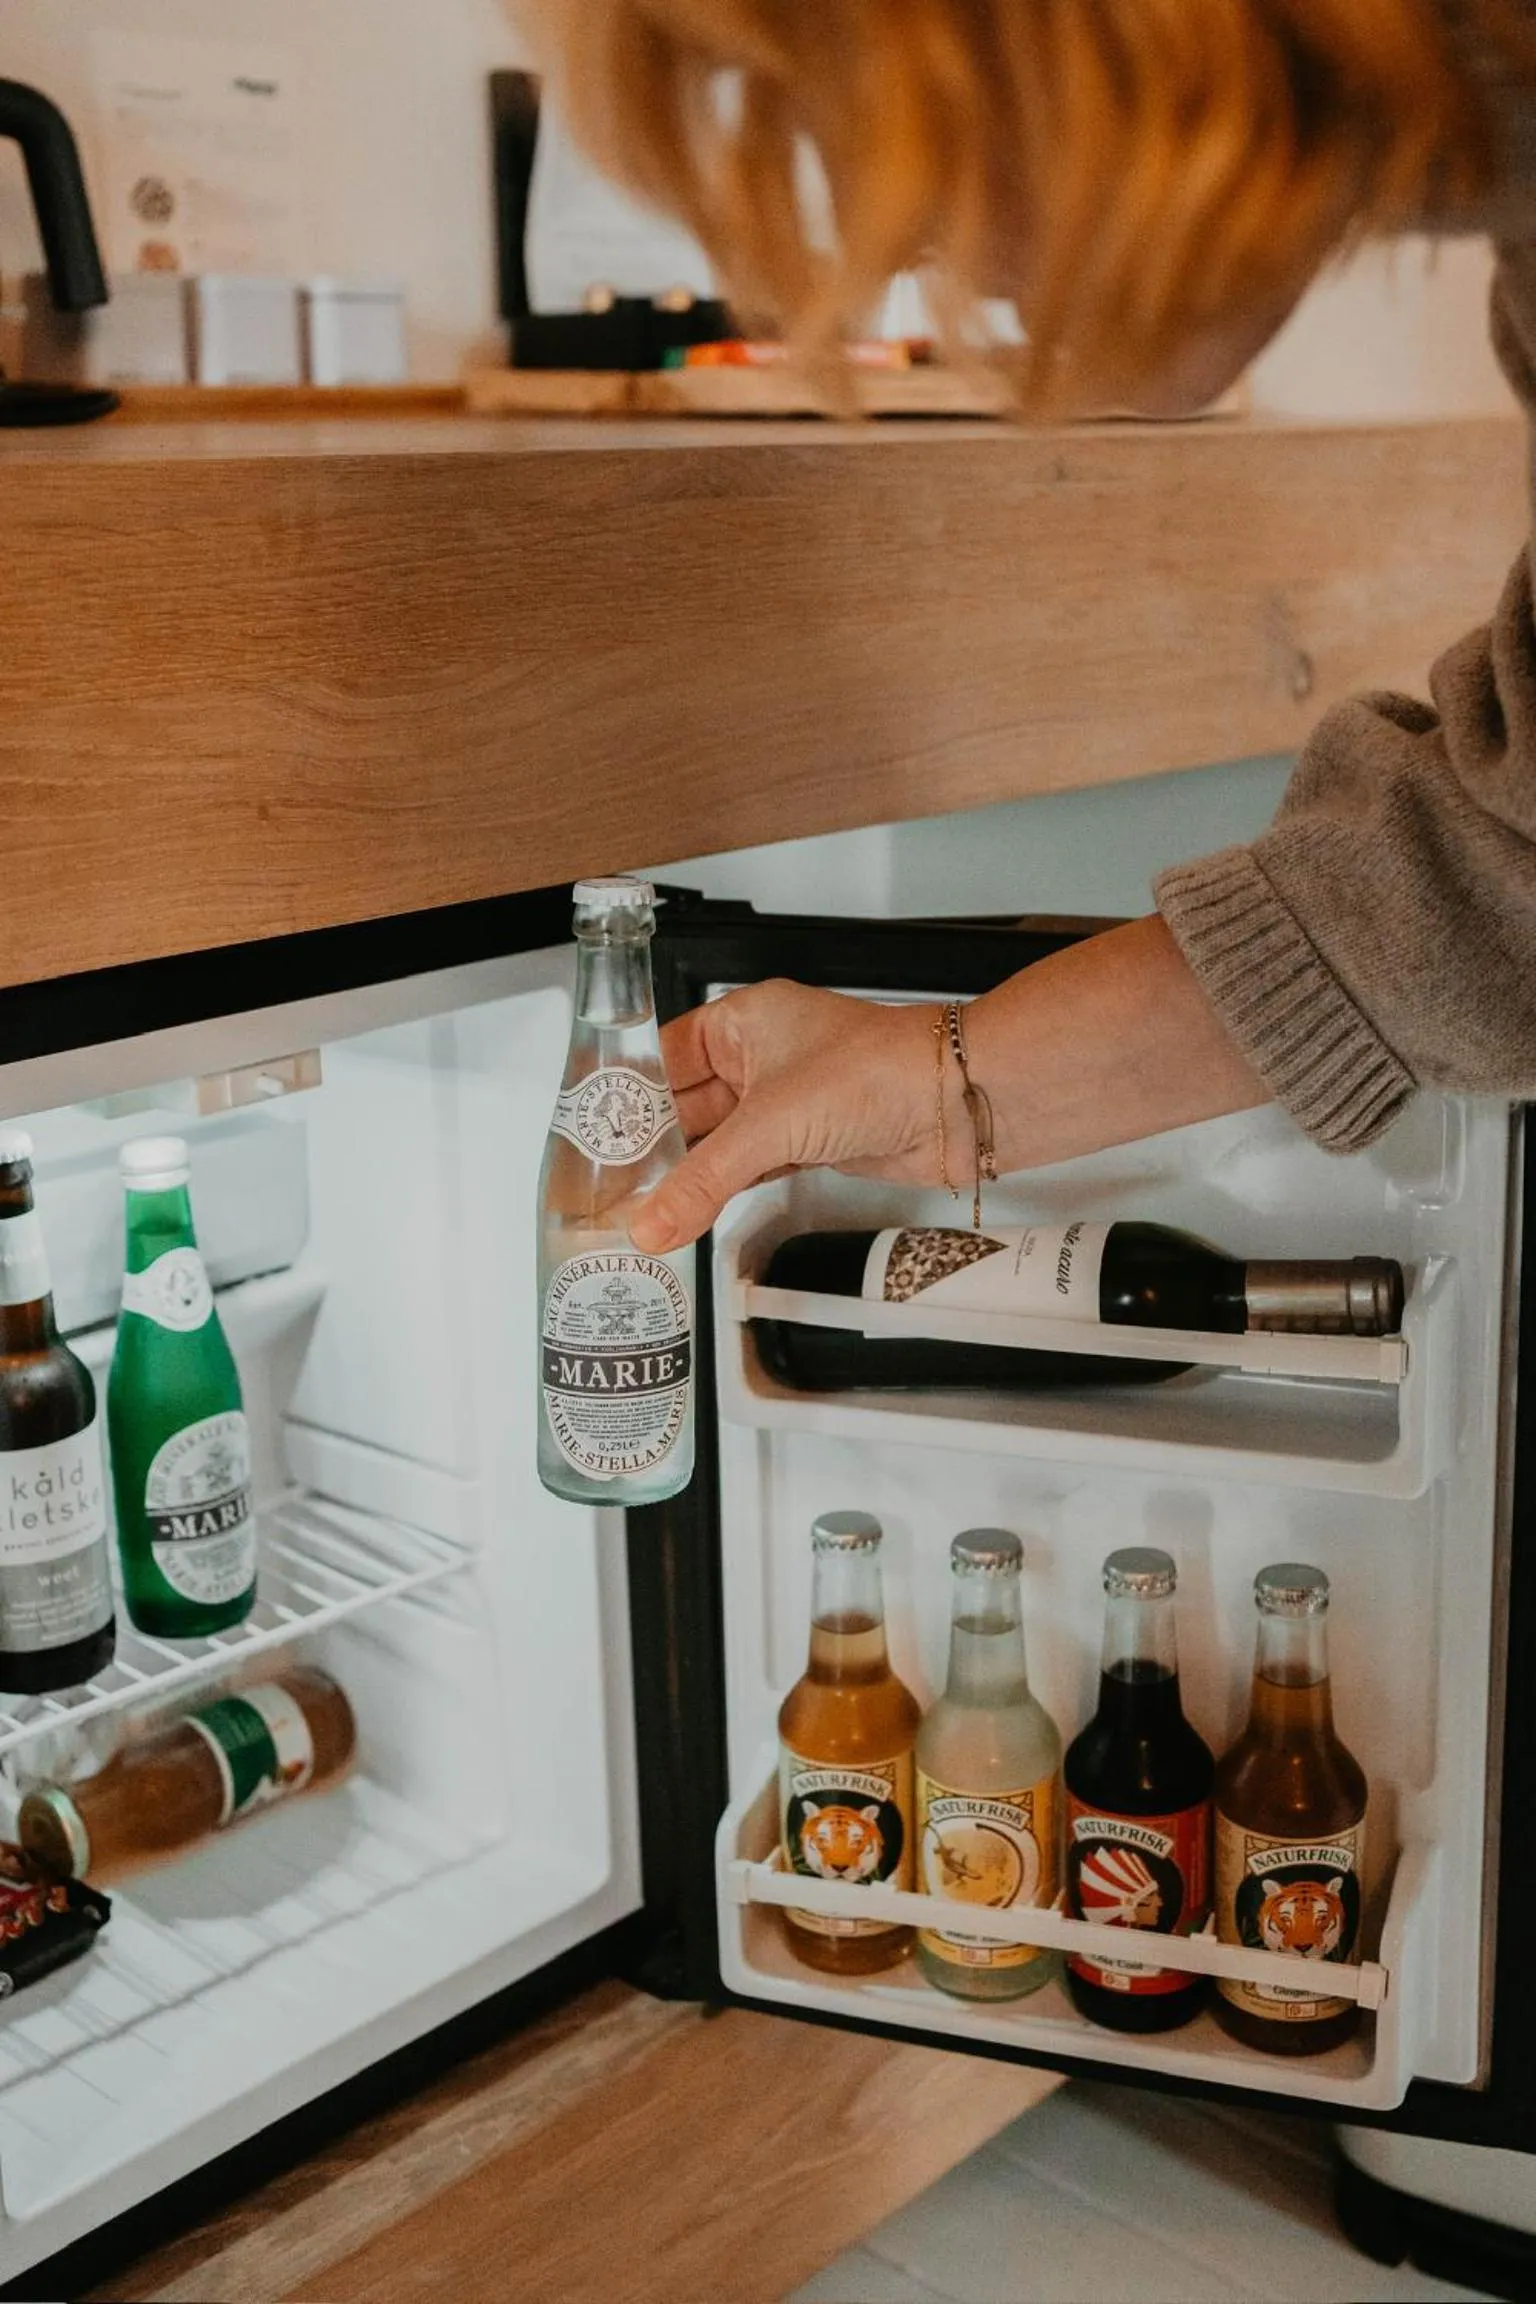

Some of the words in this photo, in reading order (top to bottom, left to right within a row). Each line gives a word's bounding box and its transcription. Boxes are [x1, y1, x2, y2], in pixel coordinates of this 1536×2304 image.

[796, 1773, 887, 1798] NATURFRISK
[932, 1799, 1025, 1826] NATURFRISK
[1076, 1820, 1168, 1852] NATURFRISK
[1253, 1848, 1351, 1869] NATURFRISK
